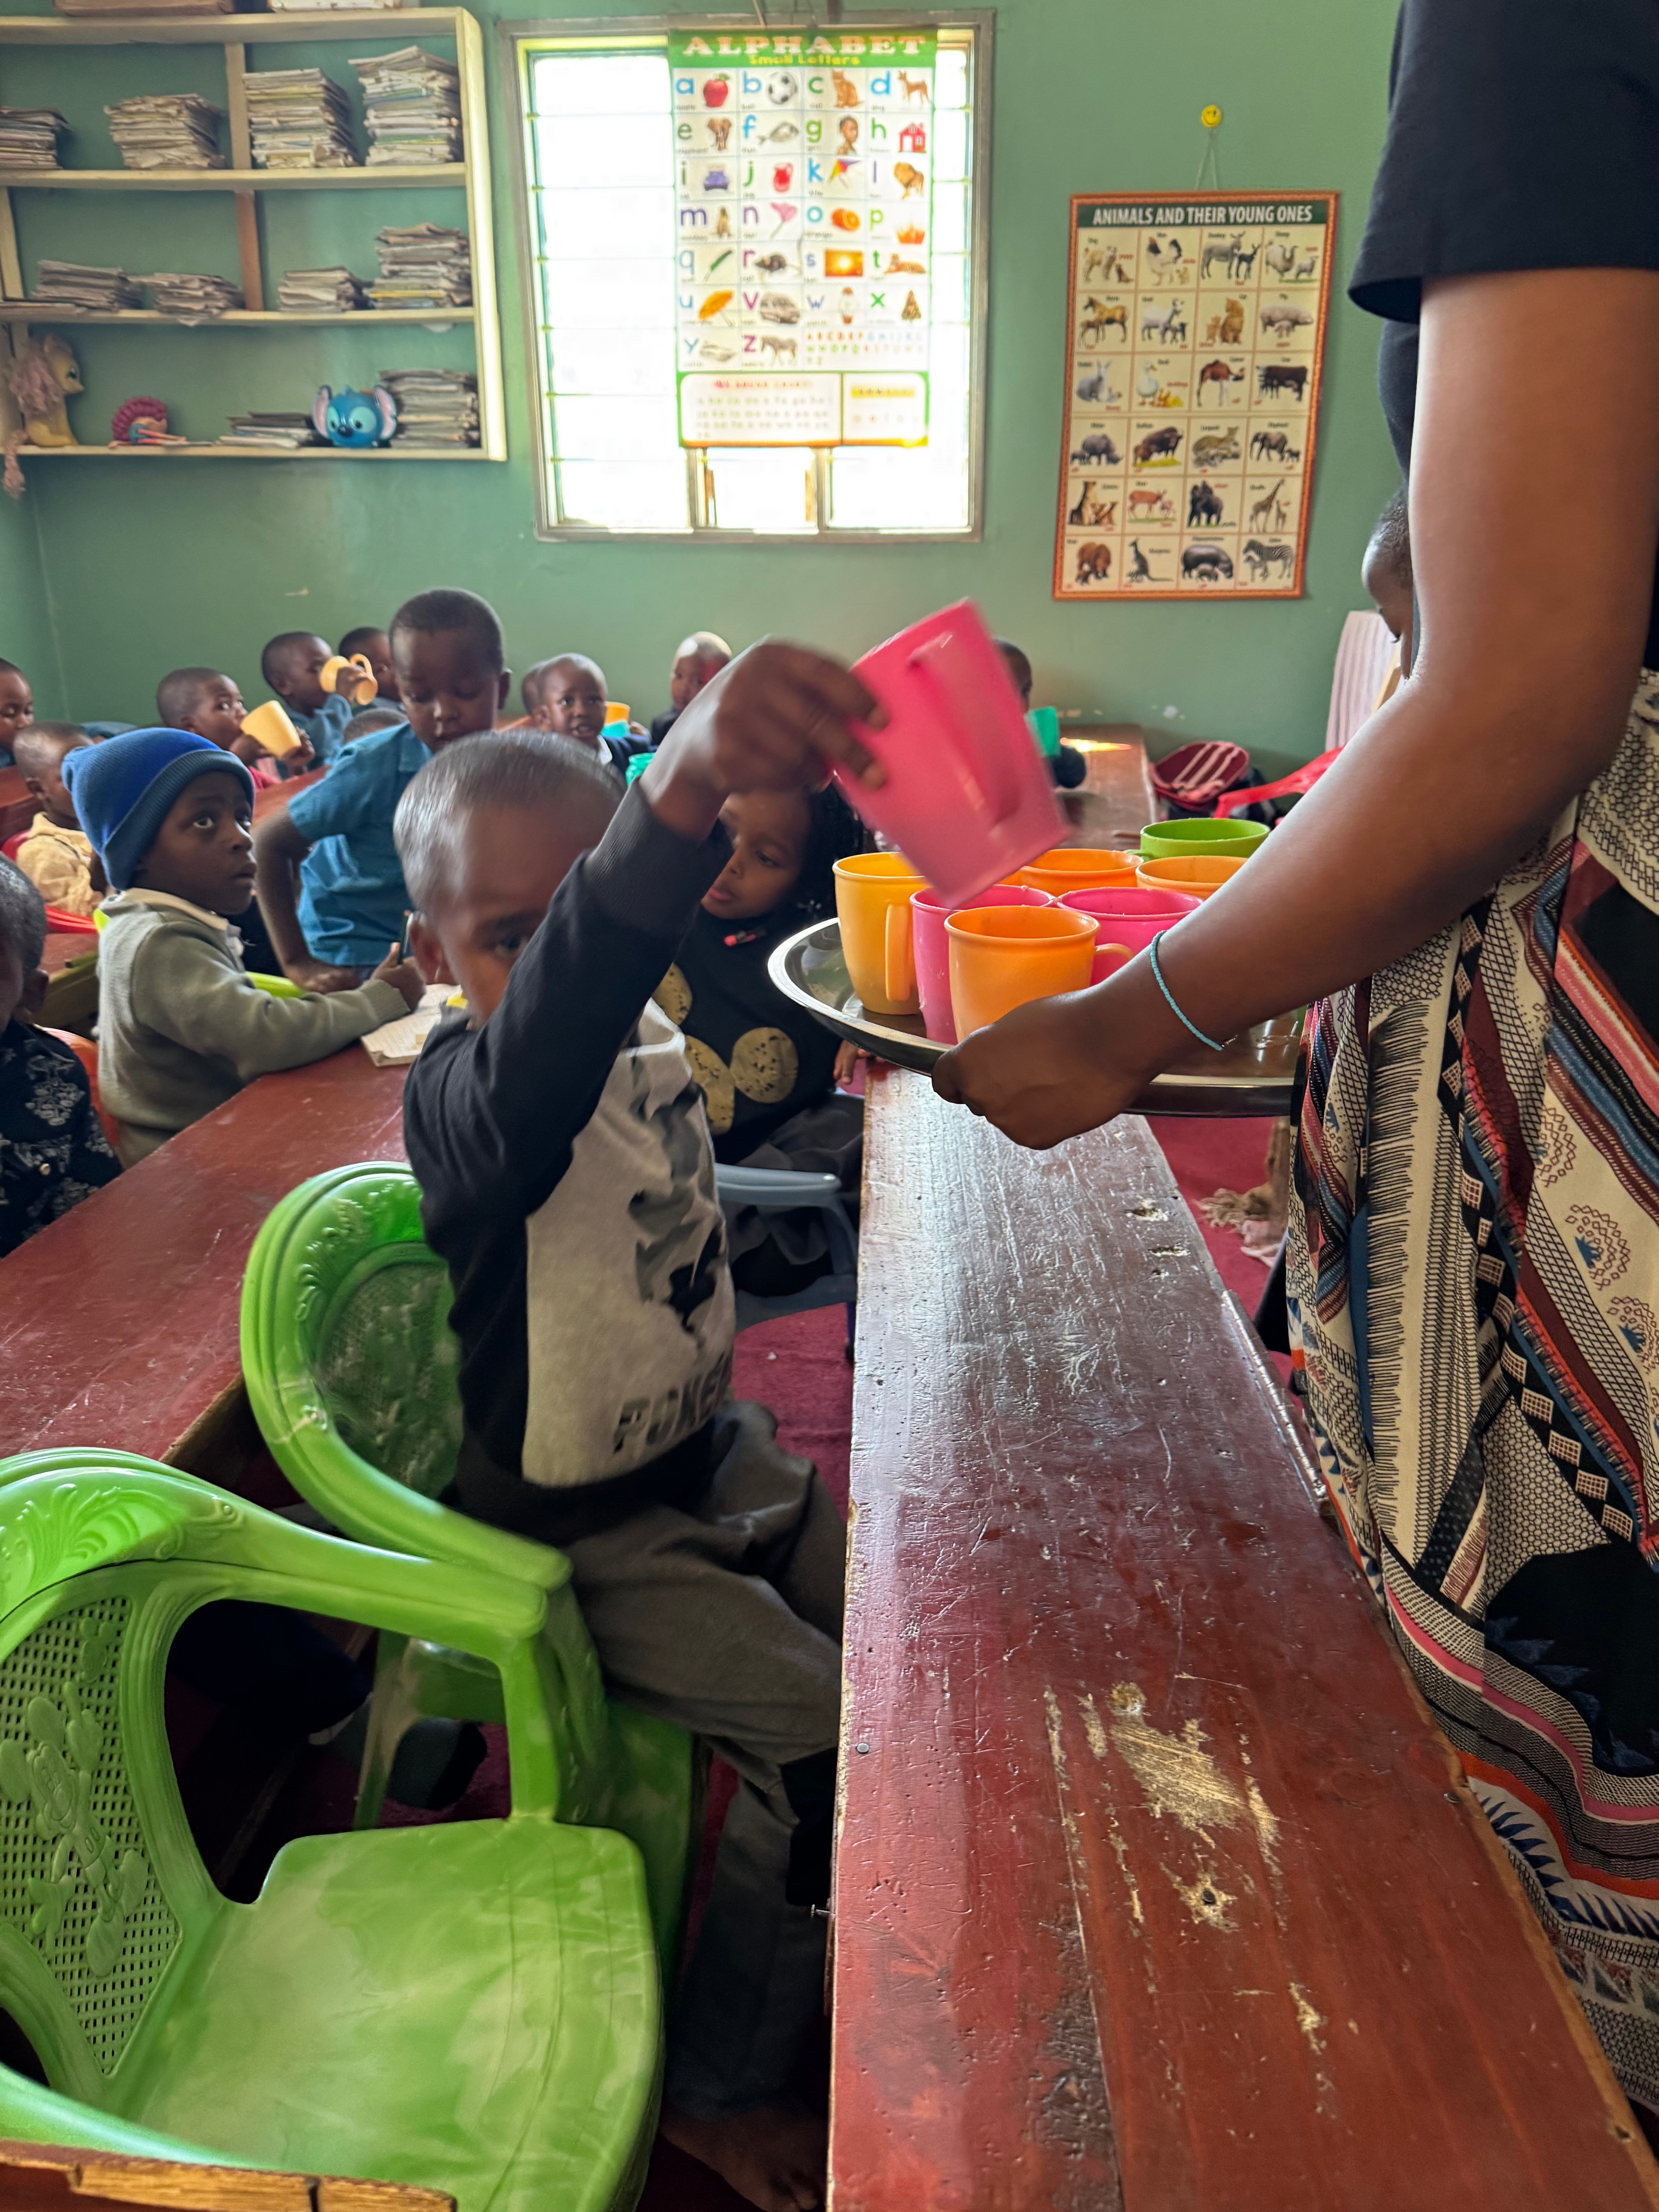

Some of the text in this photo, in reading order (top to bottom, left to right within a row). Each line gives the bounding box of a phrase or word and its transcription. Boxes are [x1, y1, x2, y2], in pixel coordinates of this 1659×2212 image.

[683, 36, 926, 55] ALPHABET
[750, 55, 859, 65] Small Letters
[676, 77, 695, 94] a
[743, 71, 761, 93] b
[871, 72, 890, 94] d
[677, 123, 692, 139] e
[743, 115, 757, 138] f
[806, 121, 822, 143] g
[872, 118, 886, 139] h
[681, 161, 687, 185] i
[743, 161, 753, 187] j
[809, 160, 823, 182] k
[681, 208, 707, 226] m
[743, 208, 758, 223] n
[870, 209, 883, 230] p
[1093, 205, 1313, 225] ANIMALS AND THEIR YOUNG ONES
[679, 250, 695, 275] q
[743, 250, 755, 268] r
[873, 250, 880, 268] t
[680, 296, 693, 309] u
